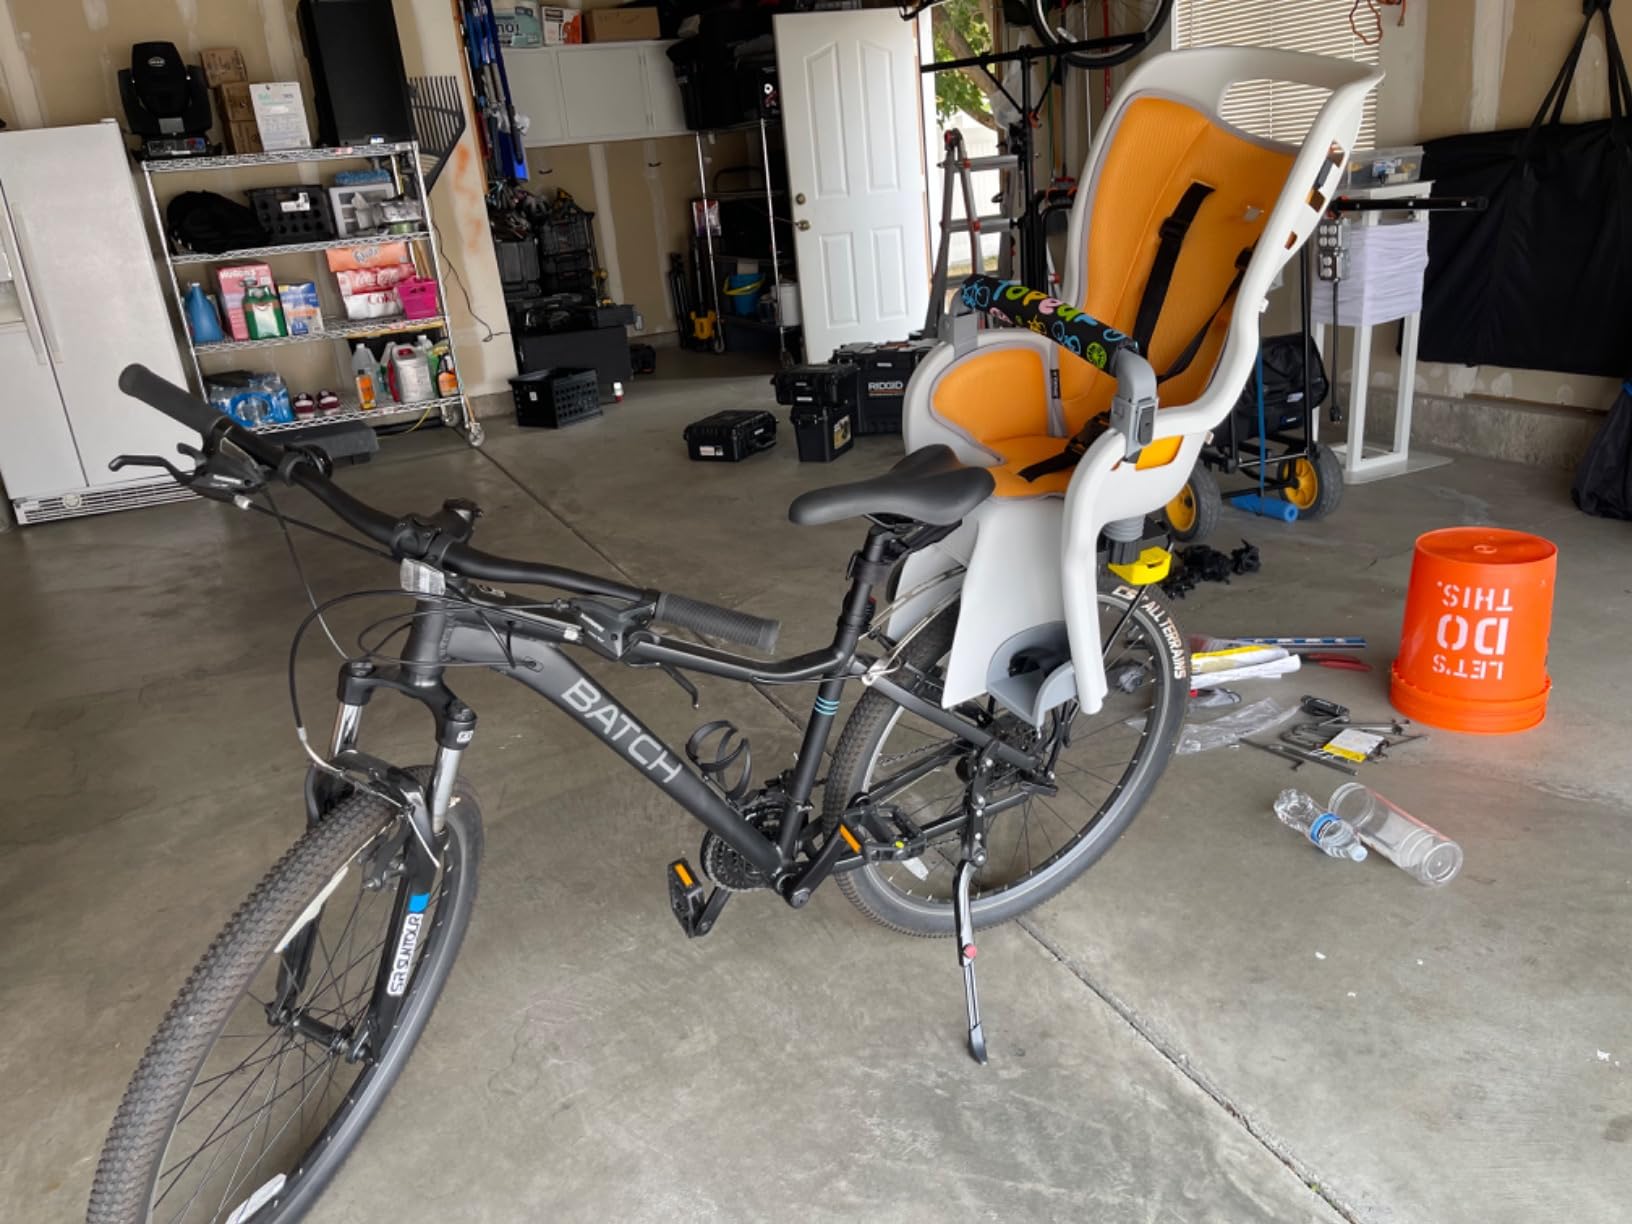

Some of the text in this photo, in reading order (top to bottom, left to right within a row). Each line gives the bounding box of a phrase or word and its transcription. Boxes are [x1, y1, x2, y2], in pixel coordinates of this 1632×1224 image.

[1436, 580, 1513, 612] THIS.
[1140, 601, 1165, 622] ALL
[1160, 616, 1187, 680] TERRAINS
[1436, 613, 1510, 656] DO
[1431, 653, 1504, 681] LET'S
[561, 677, 683, 784] BATCH
